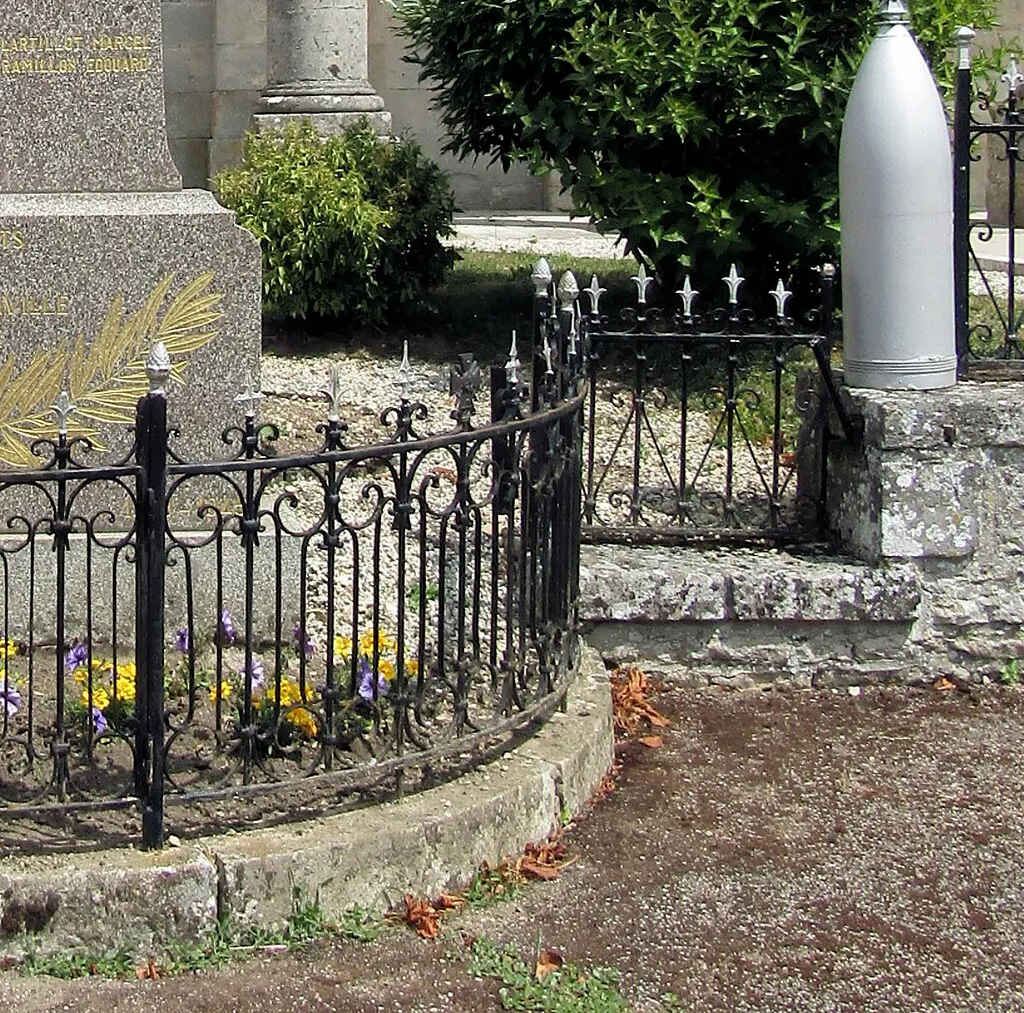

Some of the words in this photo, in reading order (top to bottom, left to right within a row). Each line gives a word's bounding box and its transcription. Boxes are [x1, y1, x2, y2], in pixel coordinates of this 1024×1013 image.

[0, 37, 84, 52] LARTILLOT
[92, 35, 152, 50] MARCEL
[1, 58, 77, 74] RAMILLON
[86, 57, 148, 73] EDOUARD
